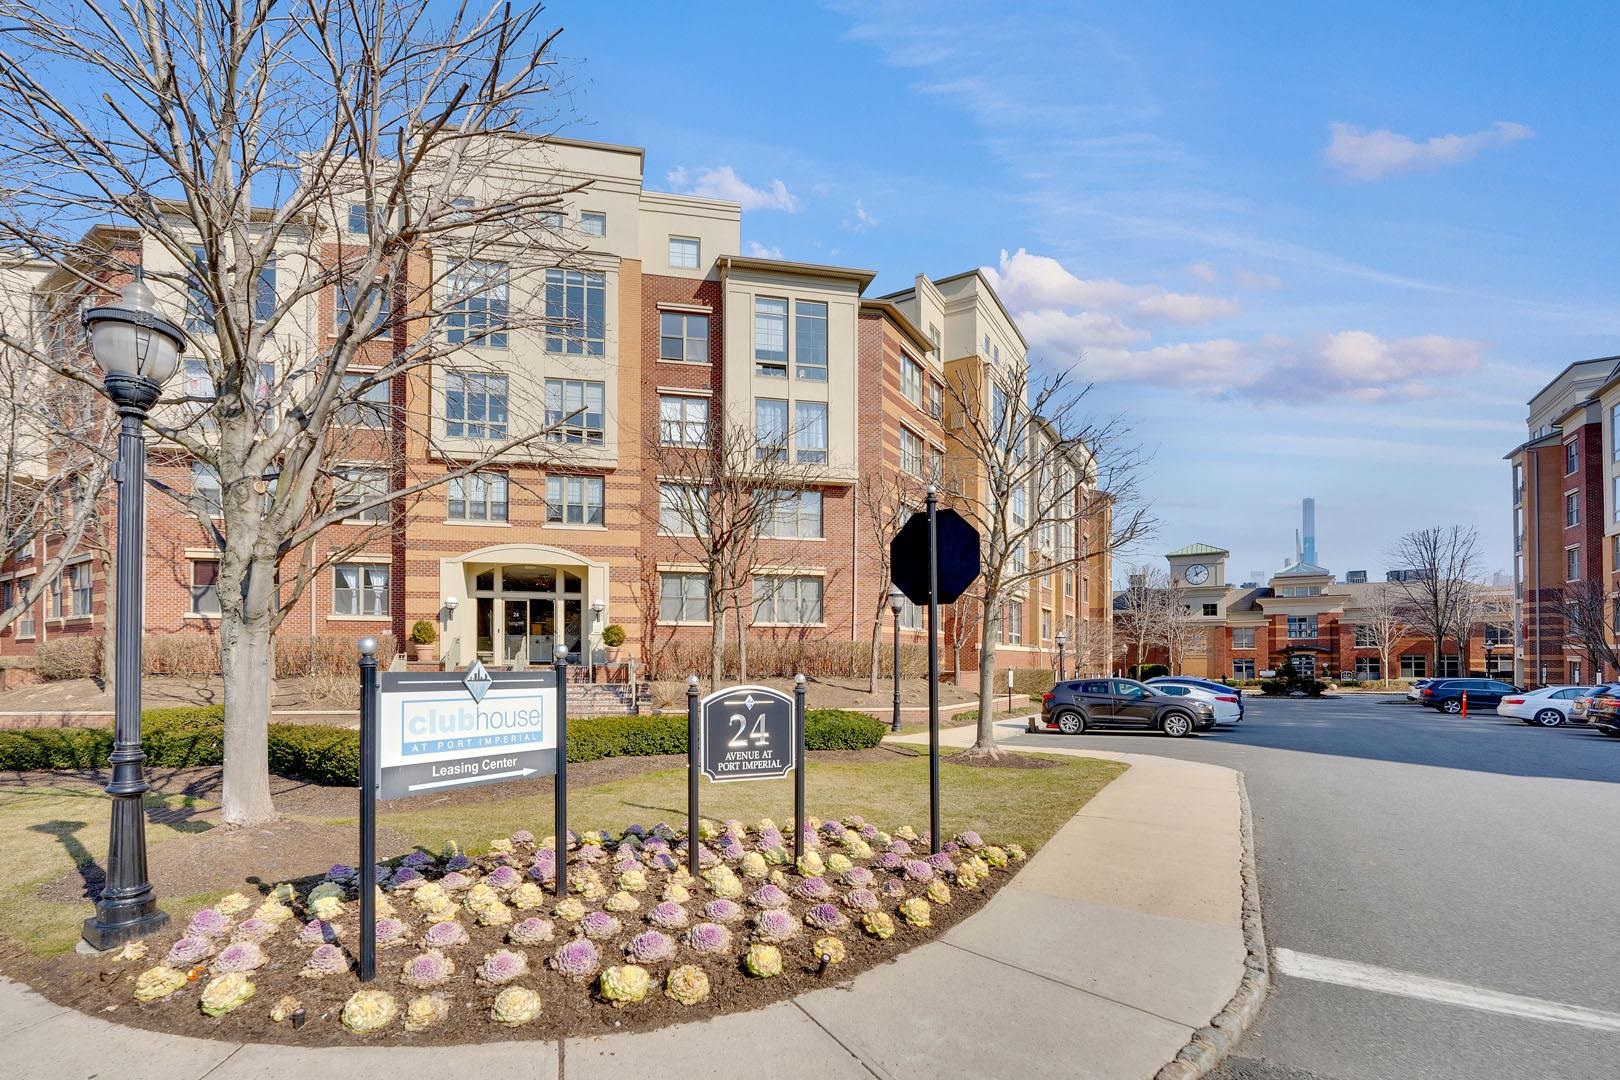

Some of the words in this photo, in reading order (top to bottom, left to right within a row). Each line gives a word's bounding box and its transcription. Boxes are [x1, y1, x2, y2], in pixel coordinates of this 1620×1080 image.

[409, 706, 540, 735] clubhouse
[728, 713, 769, 746] 24
[412, 743, 427, 753] AT
[437, 739, 472, 749] PORT
[479, 733, 537, 746] IMPERIAL
[718, 762, 741, 771] PORT
[742, 759, 782, 770] IMPERIAL
[725, 751, 760, 760] AVENUE
[761, 750, 773, 759] AT
[432, 762, 478, 777] Leasing
[482, 757, 518, 770] Center
